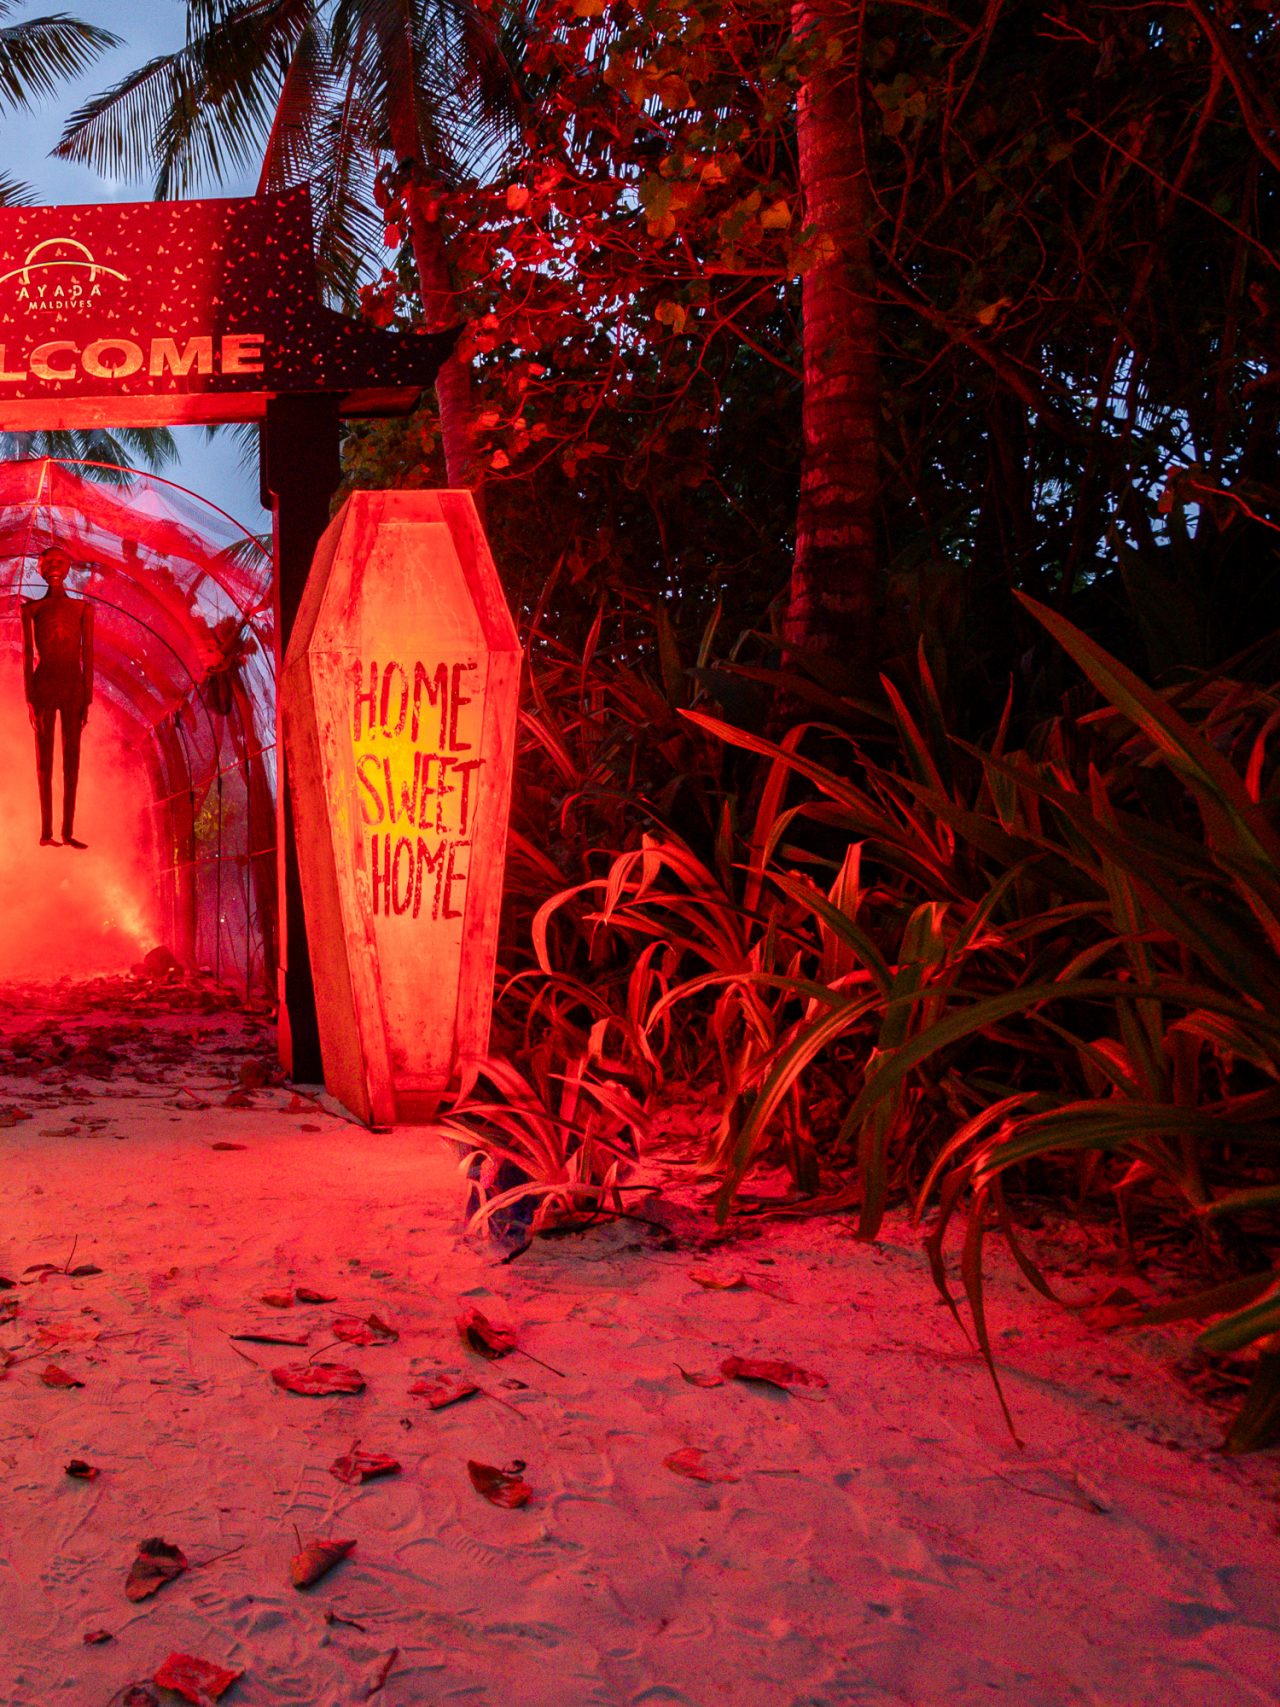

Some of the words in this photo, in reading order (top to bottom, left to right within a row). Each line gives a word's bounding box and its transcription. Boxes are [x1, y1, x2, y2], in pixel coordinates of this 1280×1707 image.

[19, 283, 102, 299] AYADA
[28, 300, 93, 310] MALDIVES
[351, 658, 478, 752] HOME
[355, 751, 486, 836] SWEET
[370, 832, 472, 921] HOME
